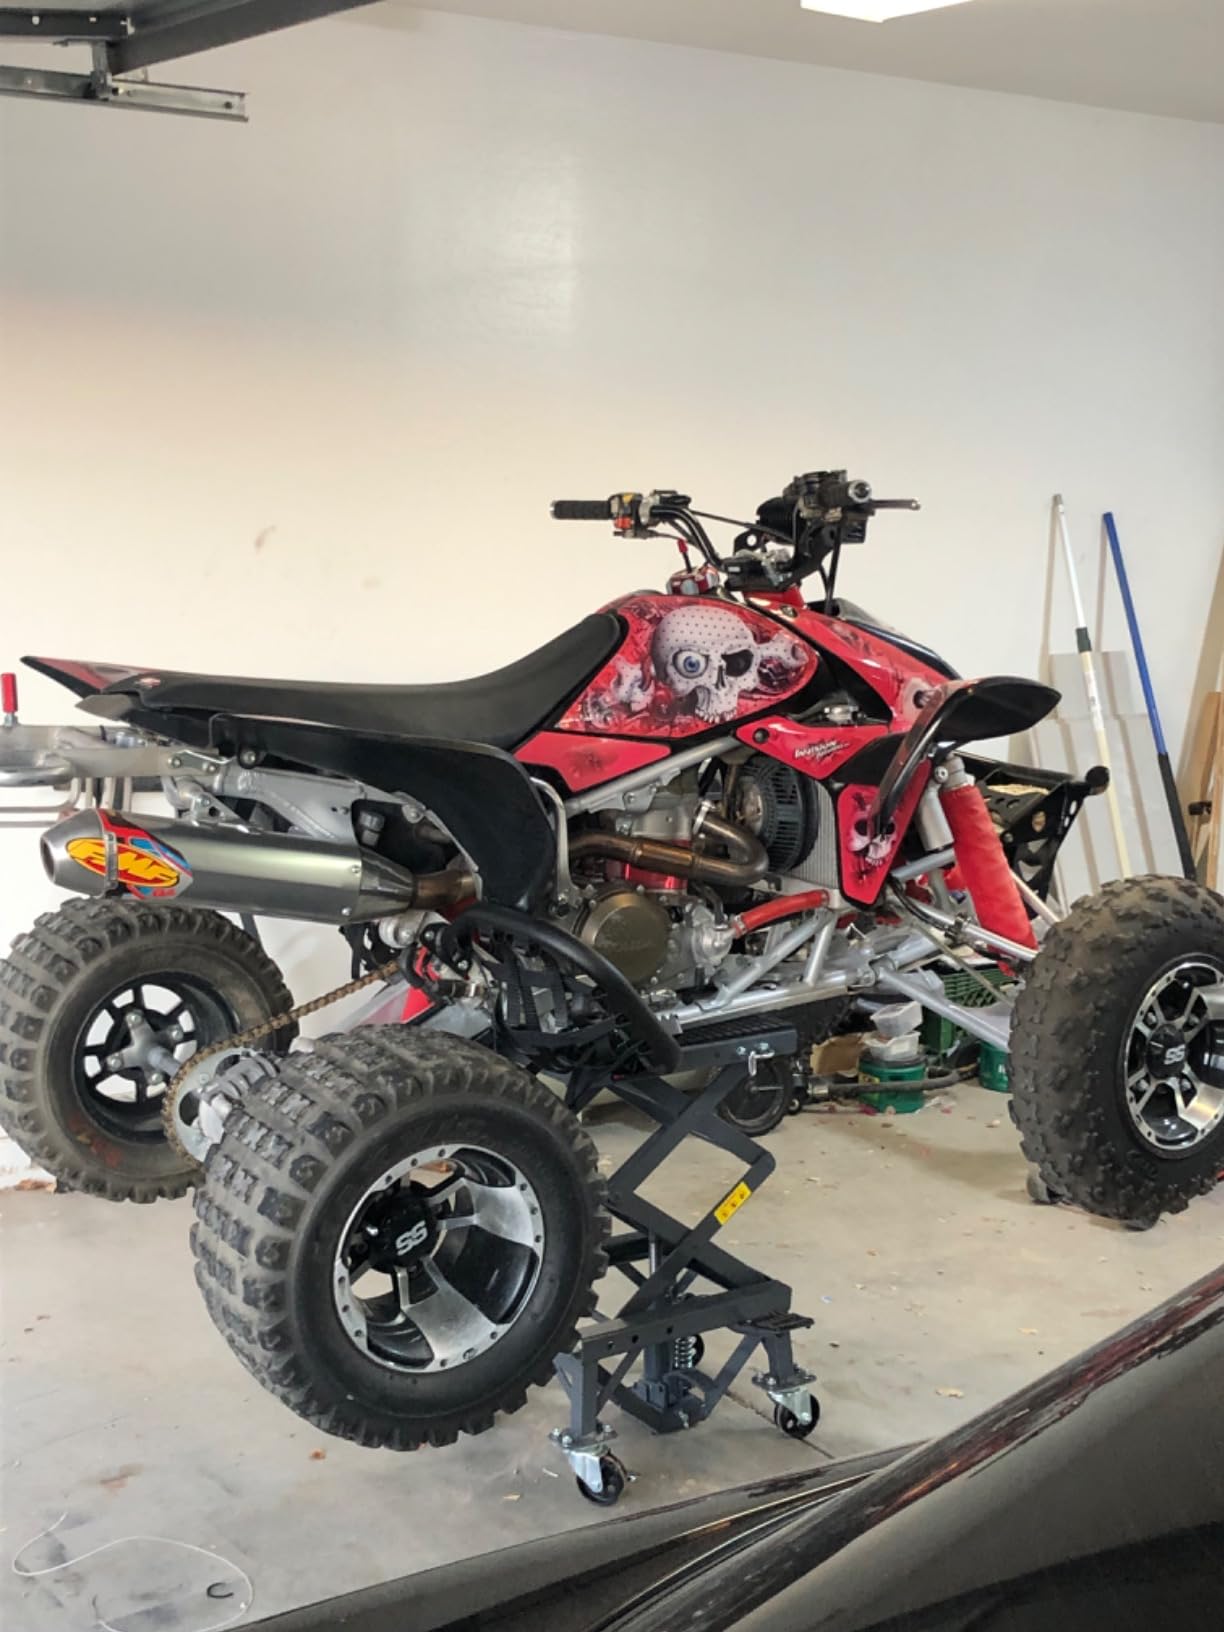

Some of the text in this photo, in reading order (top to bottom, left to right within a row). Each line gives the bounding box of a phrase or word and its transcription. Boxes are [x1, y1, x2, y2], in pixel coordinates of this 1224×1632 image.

[67, 839, 179, 885] FMF
[1164, 1044, 1186, 1065] SS
[396, 1220, 428, 1256] SS
